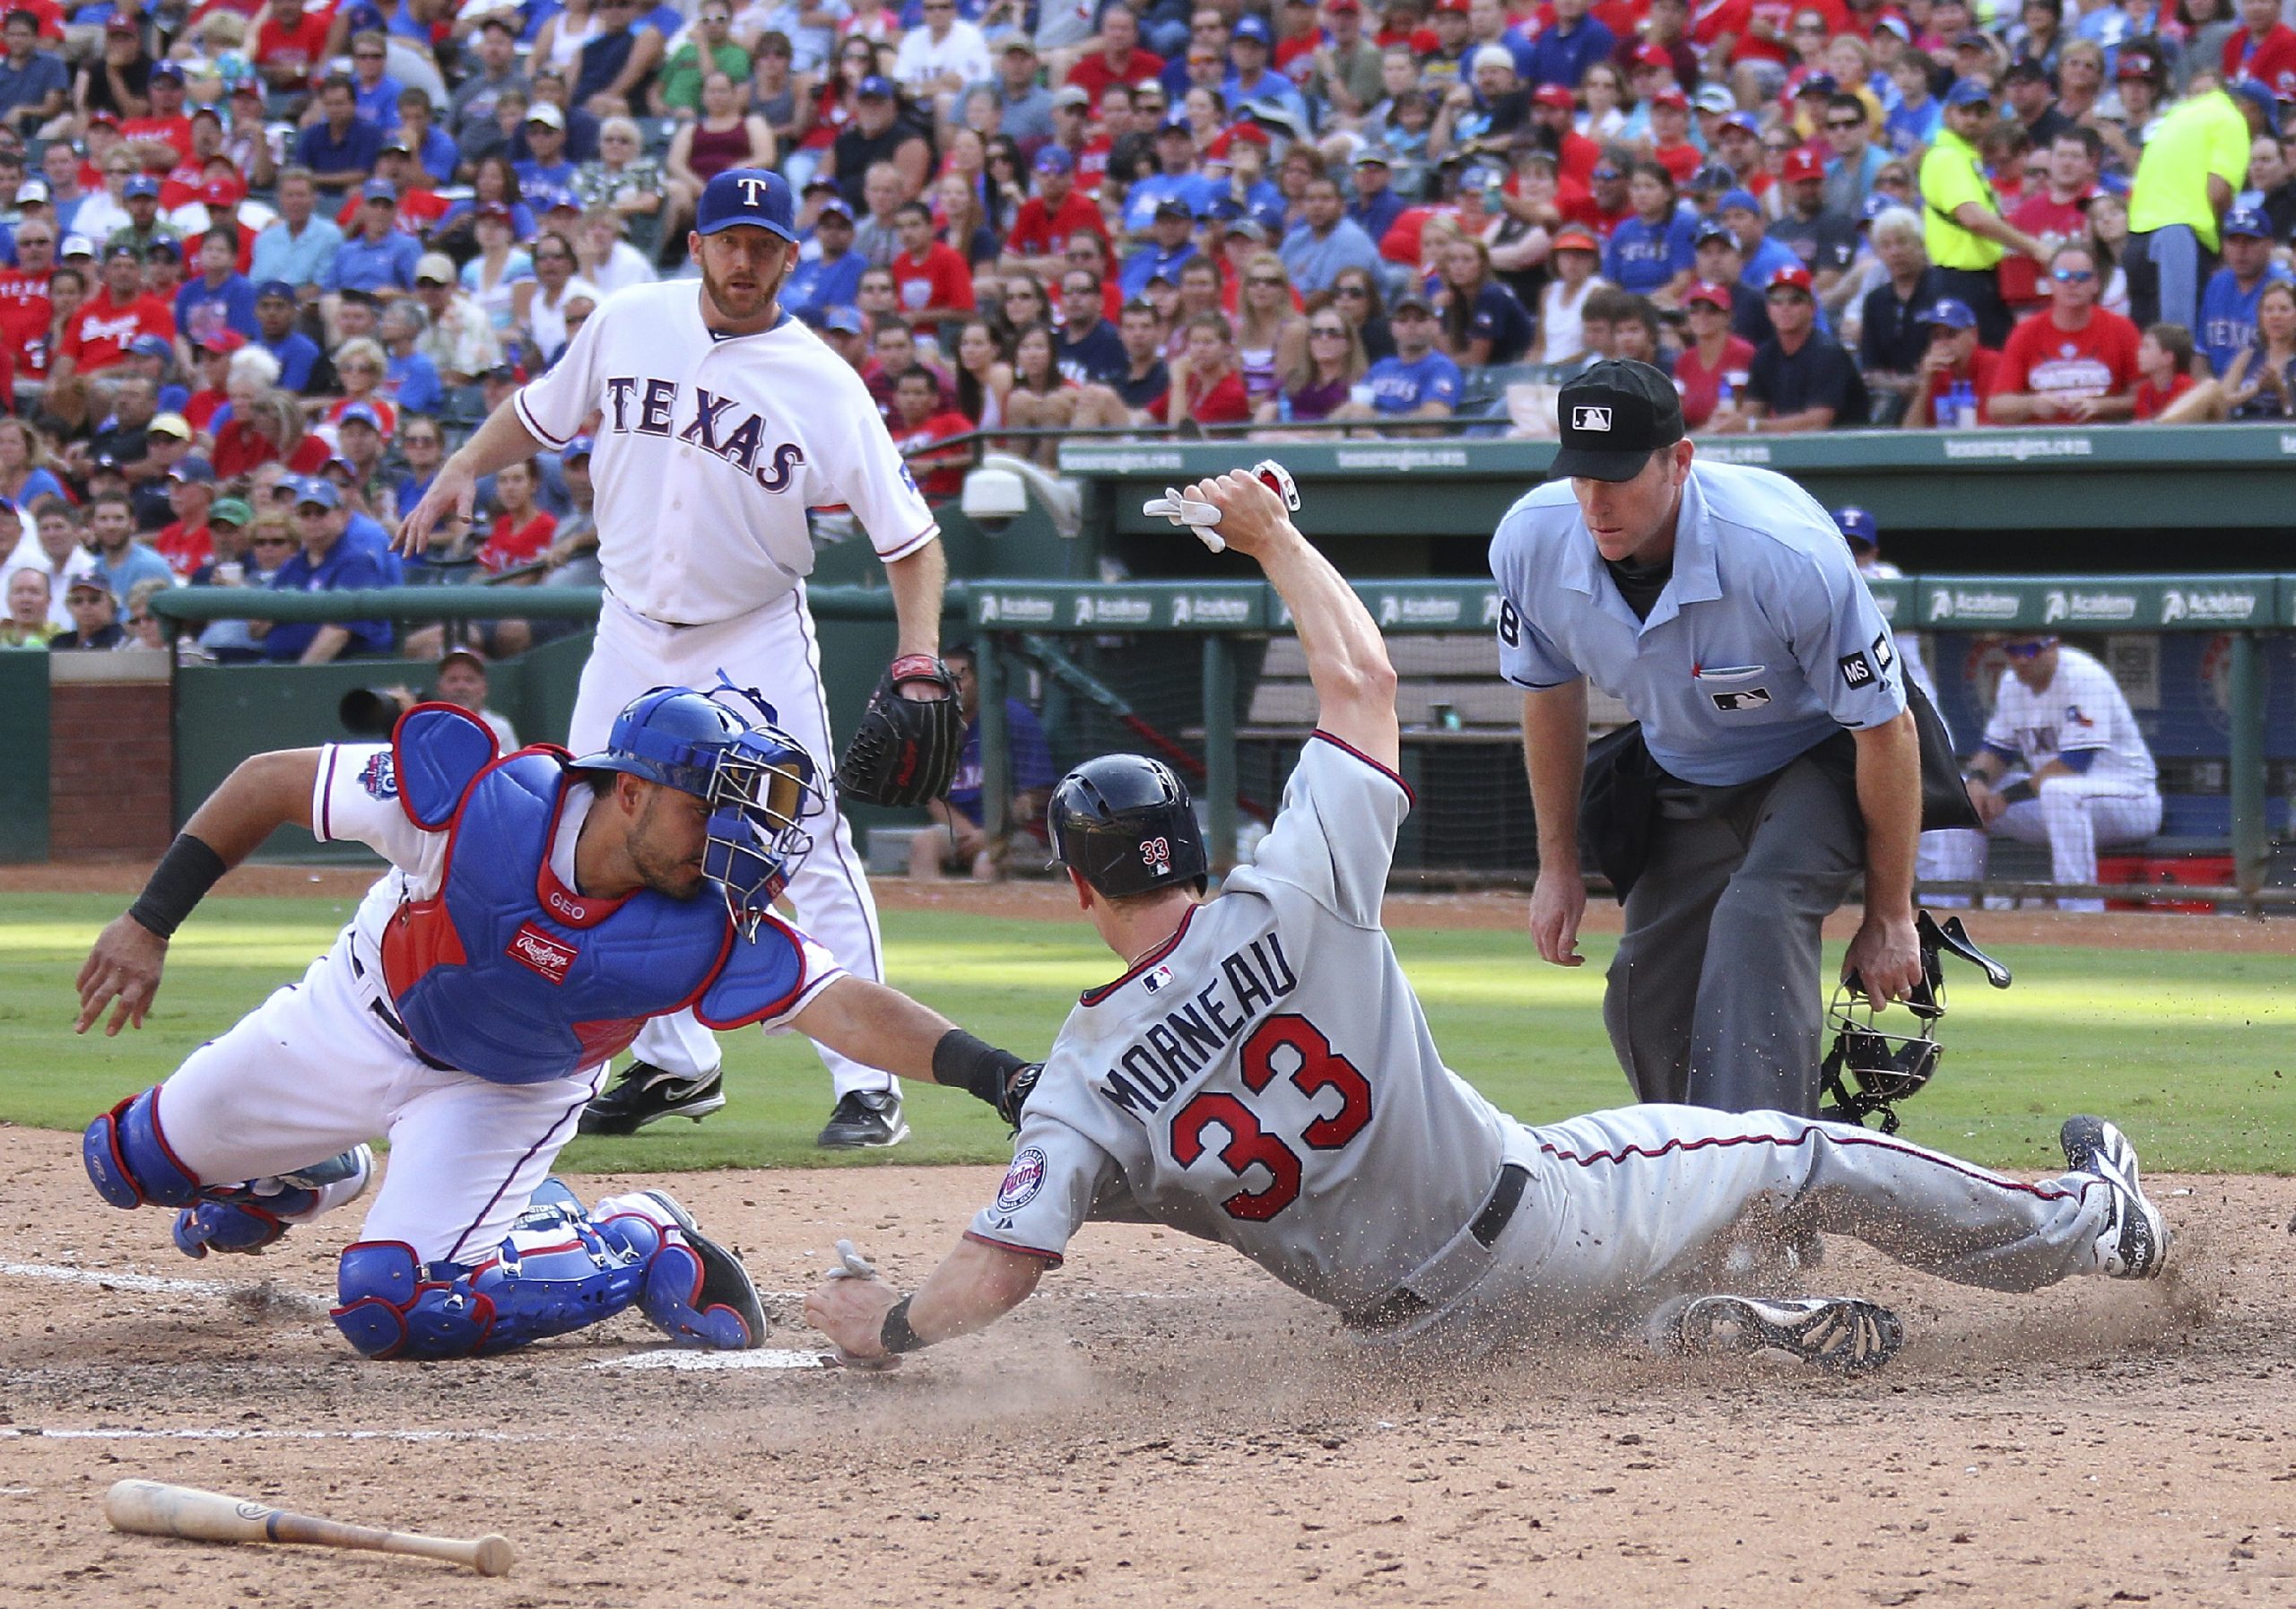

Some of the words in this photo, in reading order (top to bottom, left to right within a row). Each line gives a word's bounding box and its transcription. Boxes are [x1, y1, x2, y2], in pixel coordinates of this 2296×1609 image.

[737, 178, 767, 207] T
[606, 377, 806, 494] TEXAS
[1843, 509, 1863, 527] T
[1843, 659, 1869, 683] MS
[1139, 836, 1170, 865] 33
[550, 891, 585, 920] GEO
[516, 936, 569, 968] Rawlings
[1100, 932, 1298, 1126] MORNEAU
[1169, 1013, 1373, 1222] 33
